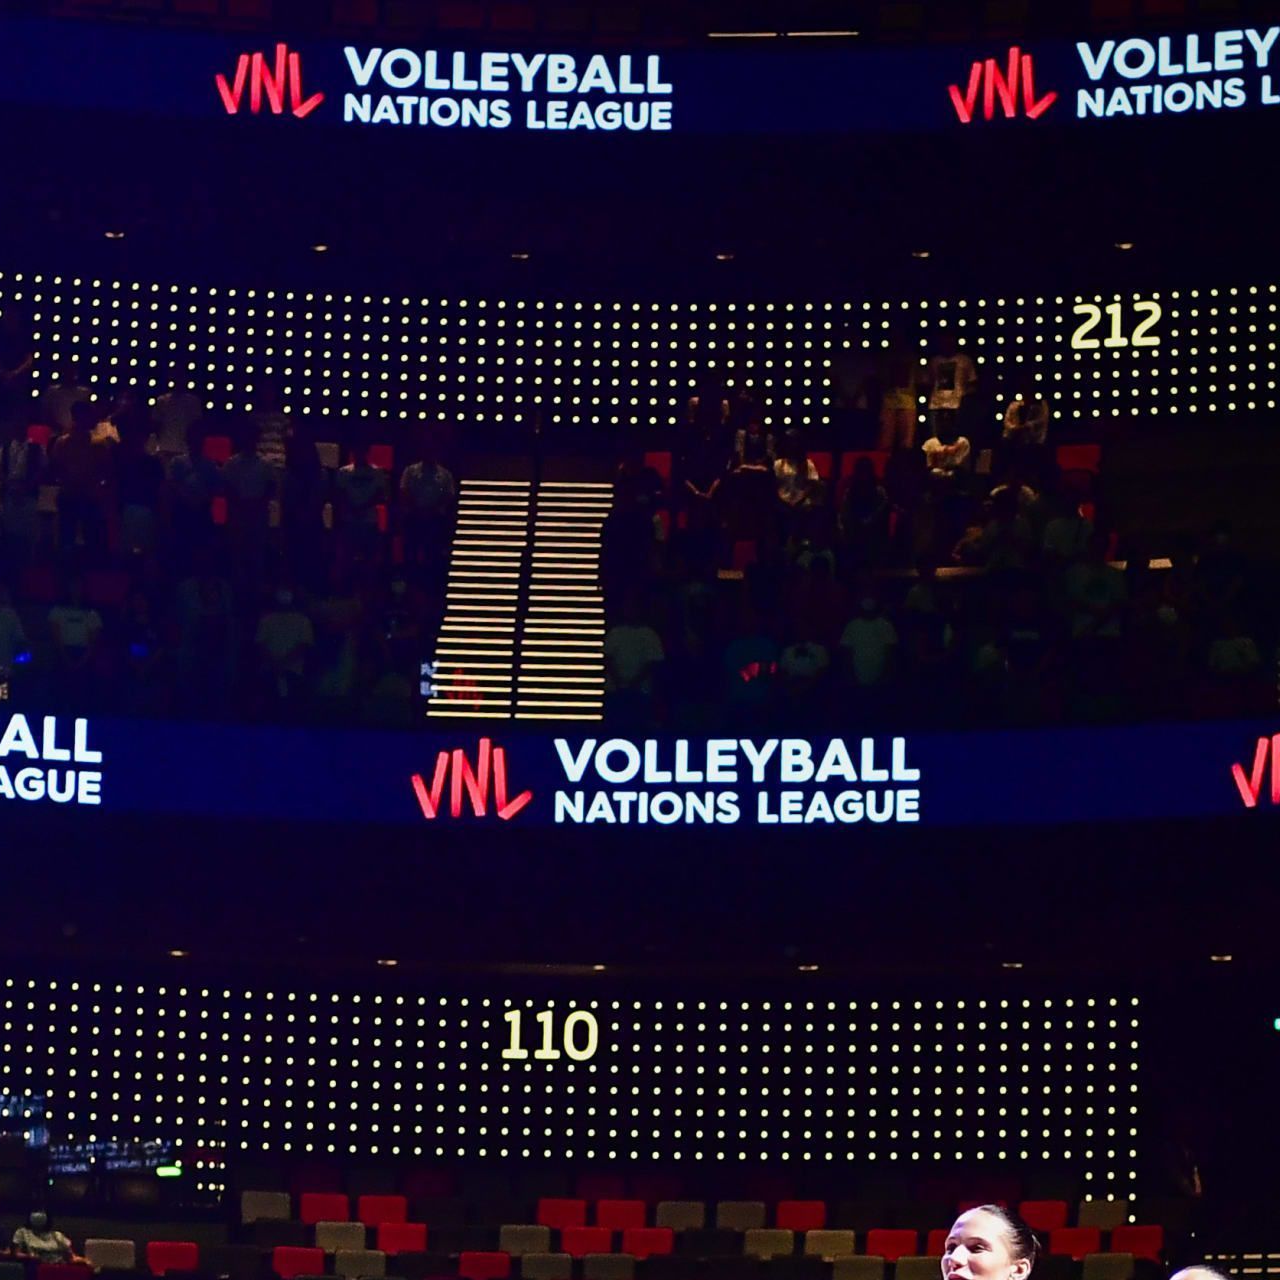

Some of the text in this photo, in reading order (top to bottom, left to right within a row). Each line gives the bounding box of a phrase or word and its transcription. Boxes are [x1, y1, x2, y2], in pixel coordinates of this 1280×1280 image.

[216, 43, 324, 118] VNL
[344, 46, 673, 94] VOLLEYBALL
[948, 46, 1057, 123] VNL
[344, 94, 673, 130] NATIONS LEAGUE
[1076, 77, 1246, 118] NATIONS
[1071, 300, 1162, 349] 212
[411, 737, 532, 820] VNL
[554, 737, 920, 784] VOLLEYBALL
[554, 789, 920, 824] NATIONS LEAGUE
[501, 1009, 599, 1061] 110
